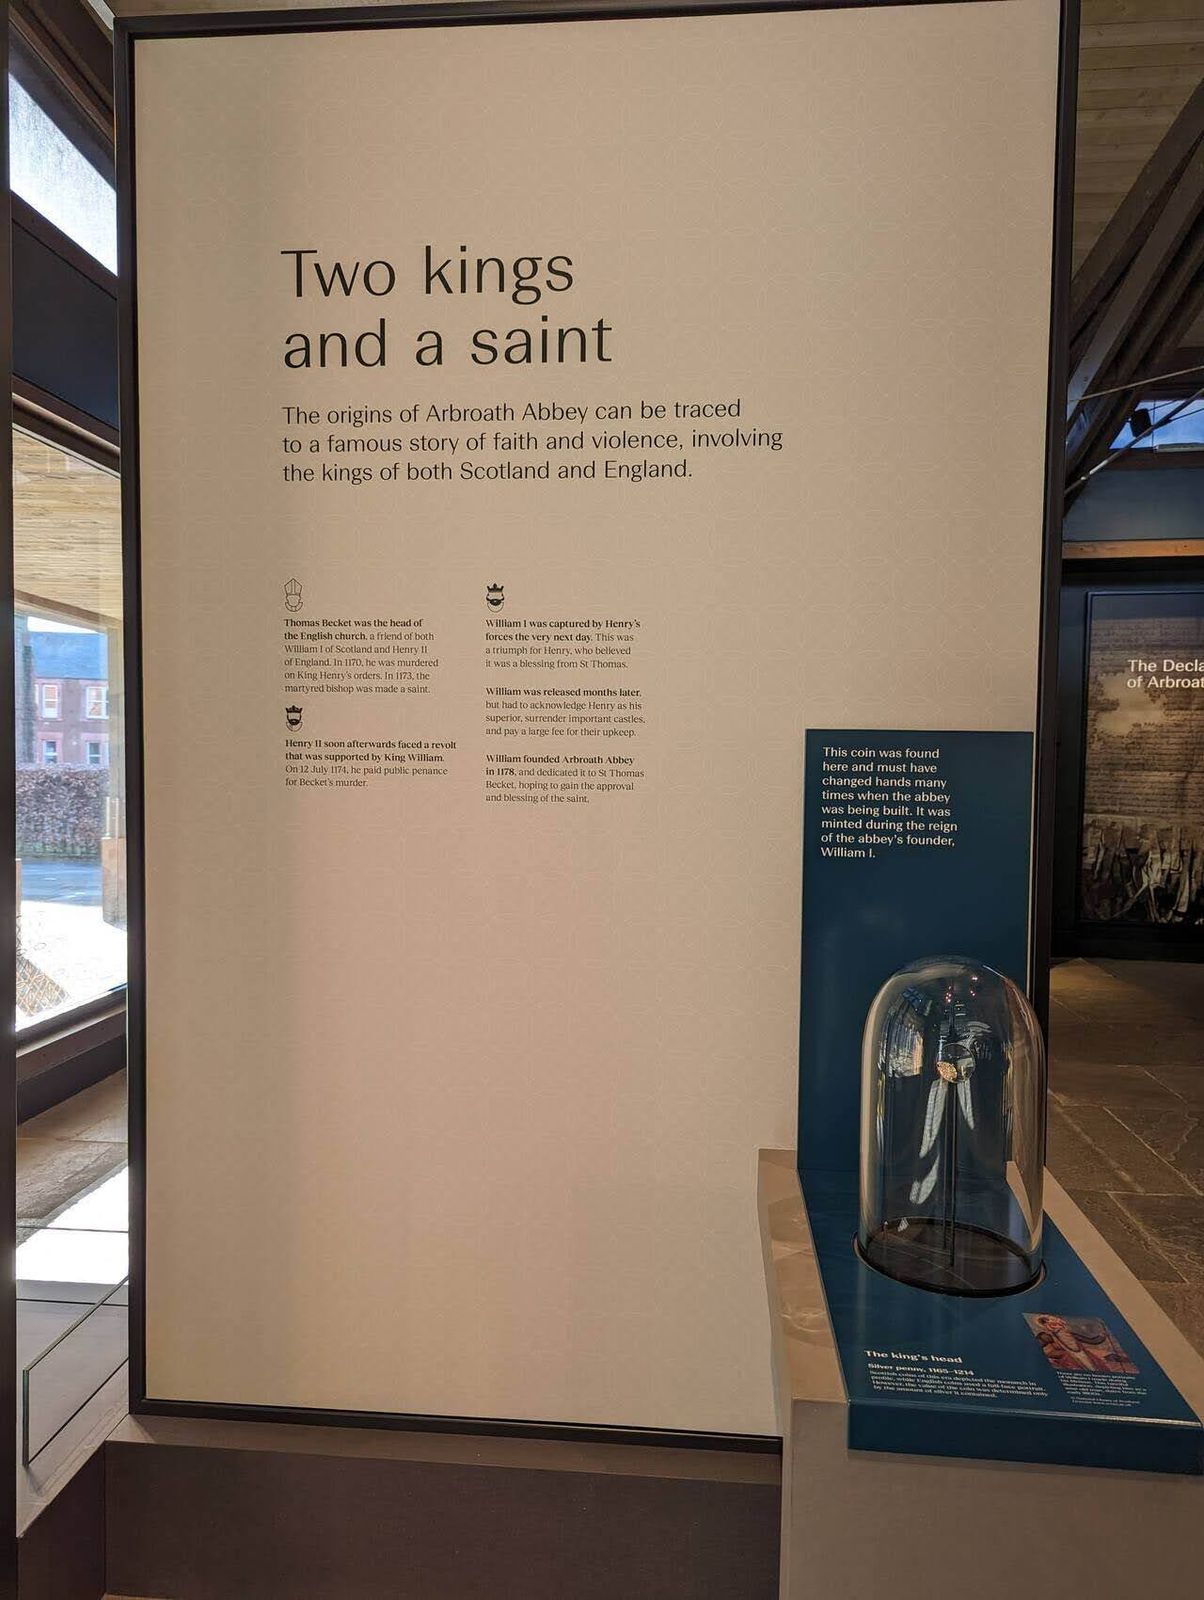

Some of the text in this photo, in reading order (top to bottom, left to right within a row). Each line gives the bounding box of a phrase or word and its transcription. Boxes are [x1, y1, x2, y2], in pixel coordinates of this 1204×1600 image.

[280, 246, 573, 304] Two kings
[284, 316, 612, 368] and a saint
[281, 398, 740, 427] The origins of Arbroath Abbey can be traced
[280, 428, 783, 454] to a famous story of faith and violence, involving
[281, 459, 692, 485] the kings of both Scotland and England.
[284, 618, 320, 626] Thomas
[413, 618, 423, 627] of
[485, 619, 521, 627] William
[548, 619, 590, 629] captured
[591, 619, 603, 629] by
[605, 619, 640, 629] Henry's
[284, 631, 298, 640] the
[300, 631, 332, 641] English
[377, 632, 402, 640] friend
[403, 631, 413, 640] of
[284, 644, 317, 653] William
[335, 645, 372, 653] Scotland
[392, 645, 418, 655] Henry
[284, 657, 293, 666] of
[345, 658, 363, 666] 1170,
[365, 658, 376, 666] he
[1128, 659, 1157, 672] The
[284, 670, 295, 679] on
[297, 670, 317, 681] King
[319, 671, 352, 681] Henry's
[384, 671, 393, 679] In
[396, 671, 414, 680] 1173,
[1127, 676, 1143, 688] of
[284, 684, 324, 694] martyred
[325, 684, 354, 694] bishop
[485, 687, 521, 695] William
[285, 739, 313, 748] Henry
[346, 740, 396, 748] afterwards
[398, 740, 422, 748] faced
[285, 752, 303, 761] that
[324, 753, 369, 762] supported
[371, 753, 382, 763] by
[384, 753, 405, 762] King
[822, 747, 847, 757] This
[850, 747, 875, 757] coin
[905, 748, 939, 758] found
[486, 754, 521, 762] William
[523, 755, 560, 763] founded
[604, 756, 634, 765] Abbey
[285, 764, 298, 774] On
[300, 764, 308, 774] 12
[310, 765, 328, 775] July
[331, 765, 348, 774] 1174,
[350, 765, 361, 773] he
[363, 766, 381, 775] paid
[384, 766, 409, 775] public
[822, 761, 937, 772] here and must have
[285, 777, 297, 786] for
[299, 778, 333, 786] Becket's
[822, 776, 946, 789] changed hands many
[822, 790, 950, 803] times when the abbey
[847, 804, 879, 817] being
[883, 805, 912, 815] built.
[916, 806, 924, 815] It
[821, 818, 957, 833] minted during the reign
[820, 832, 954, 845] of the abbey's founder,
[820, 847, 875, 857] William I.
[891, 1352, 928, 1360] king's
